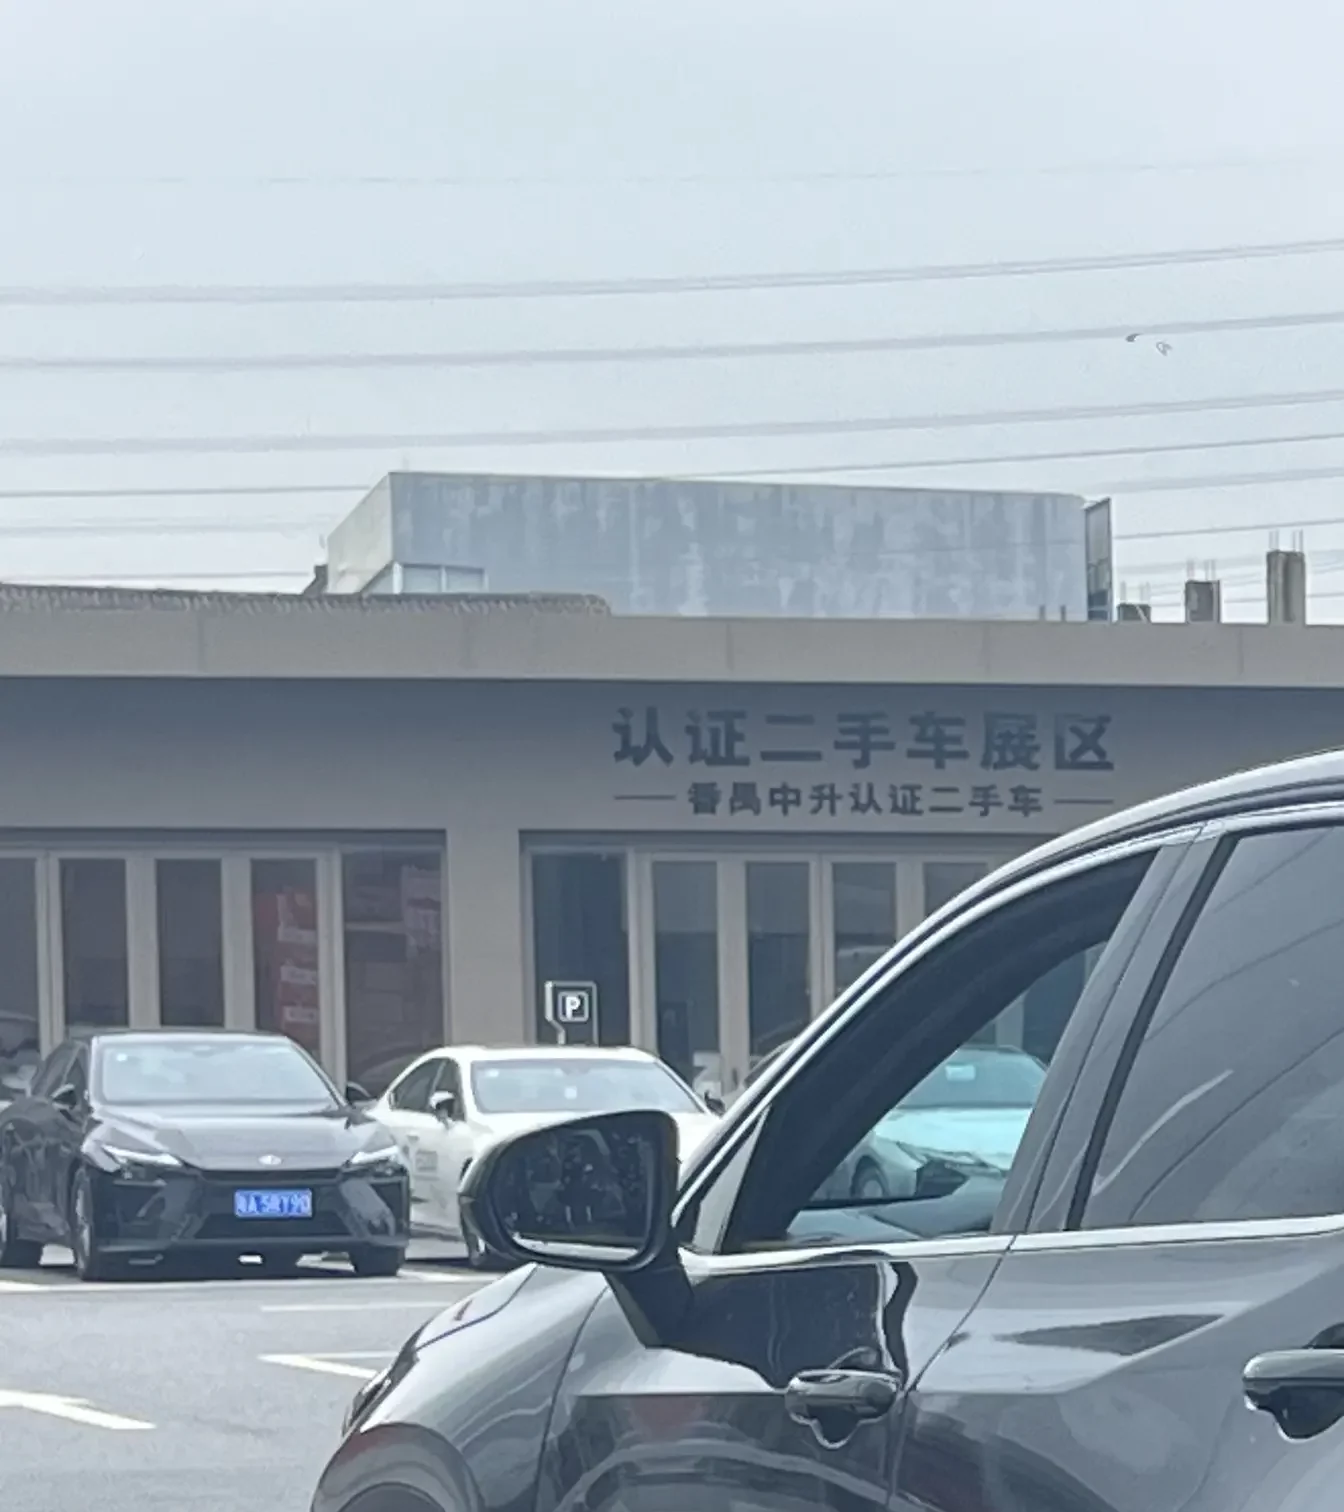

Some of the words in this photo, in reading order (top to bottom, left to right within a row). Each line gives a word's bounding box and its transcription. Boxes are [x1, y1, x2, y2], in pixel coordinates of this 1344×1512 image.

[611, 706, 1115, 770] 认证二手车展区
[687, 781, 1044, 818] 番禺中升认证二手车
[565, 995, 581, 1017] P
